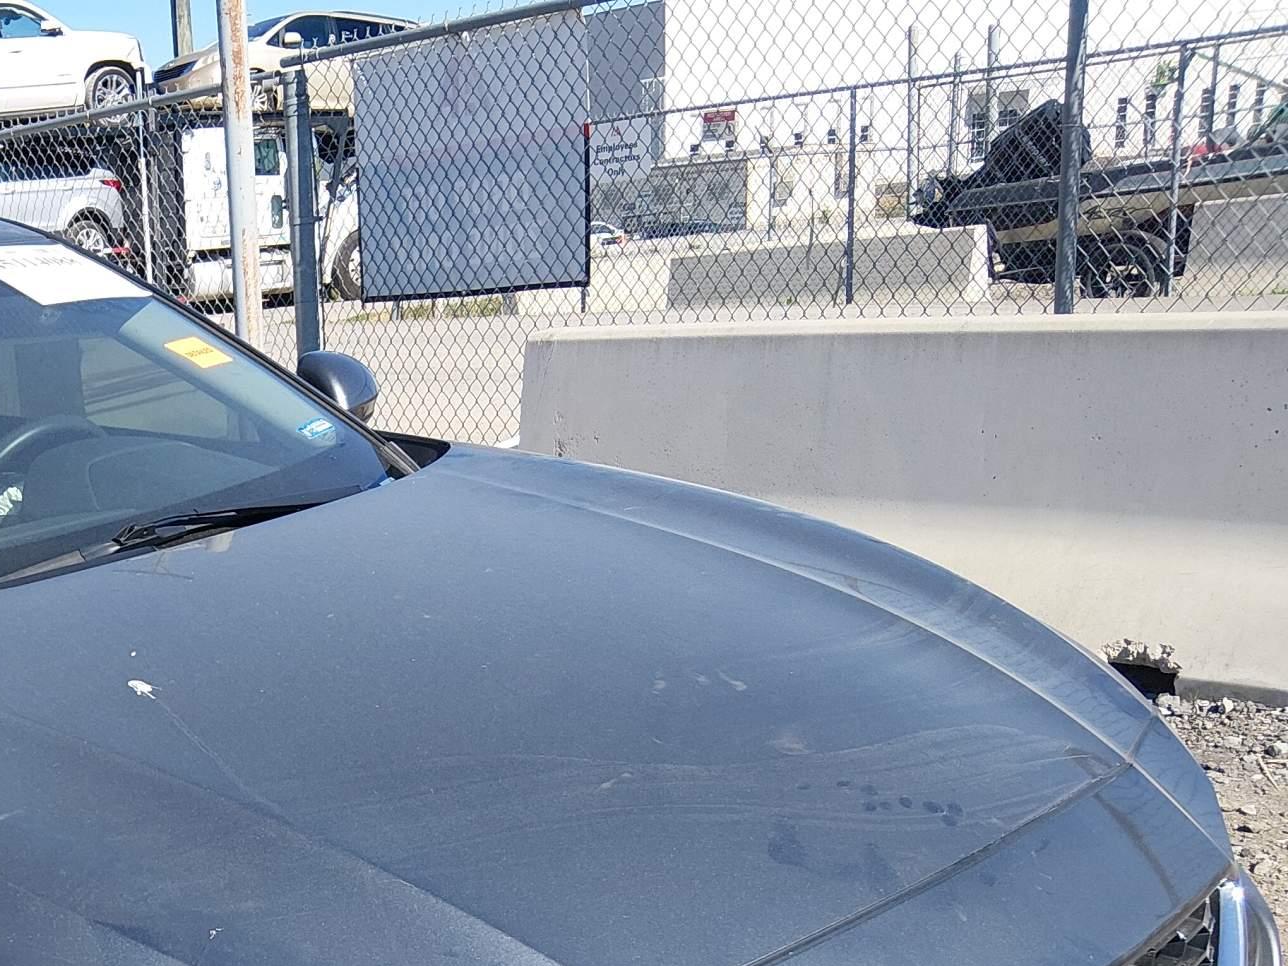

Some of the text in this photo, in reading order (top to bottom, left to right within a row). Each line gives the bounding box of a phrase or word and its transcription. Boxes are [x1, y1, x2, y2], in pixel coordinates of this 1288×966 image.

[596, 142, 638, 153] Employees
[594, 155, 641, 166] Contractors
[607, 167, 625, 177] Only
